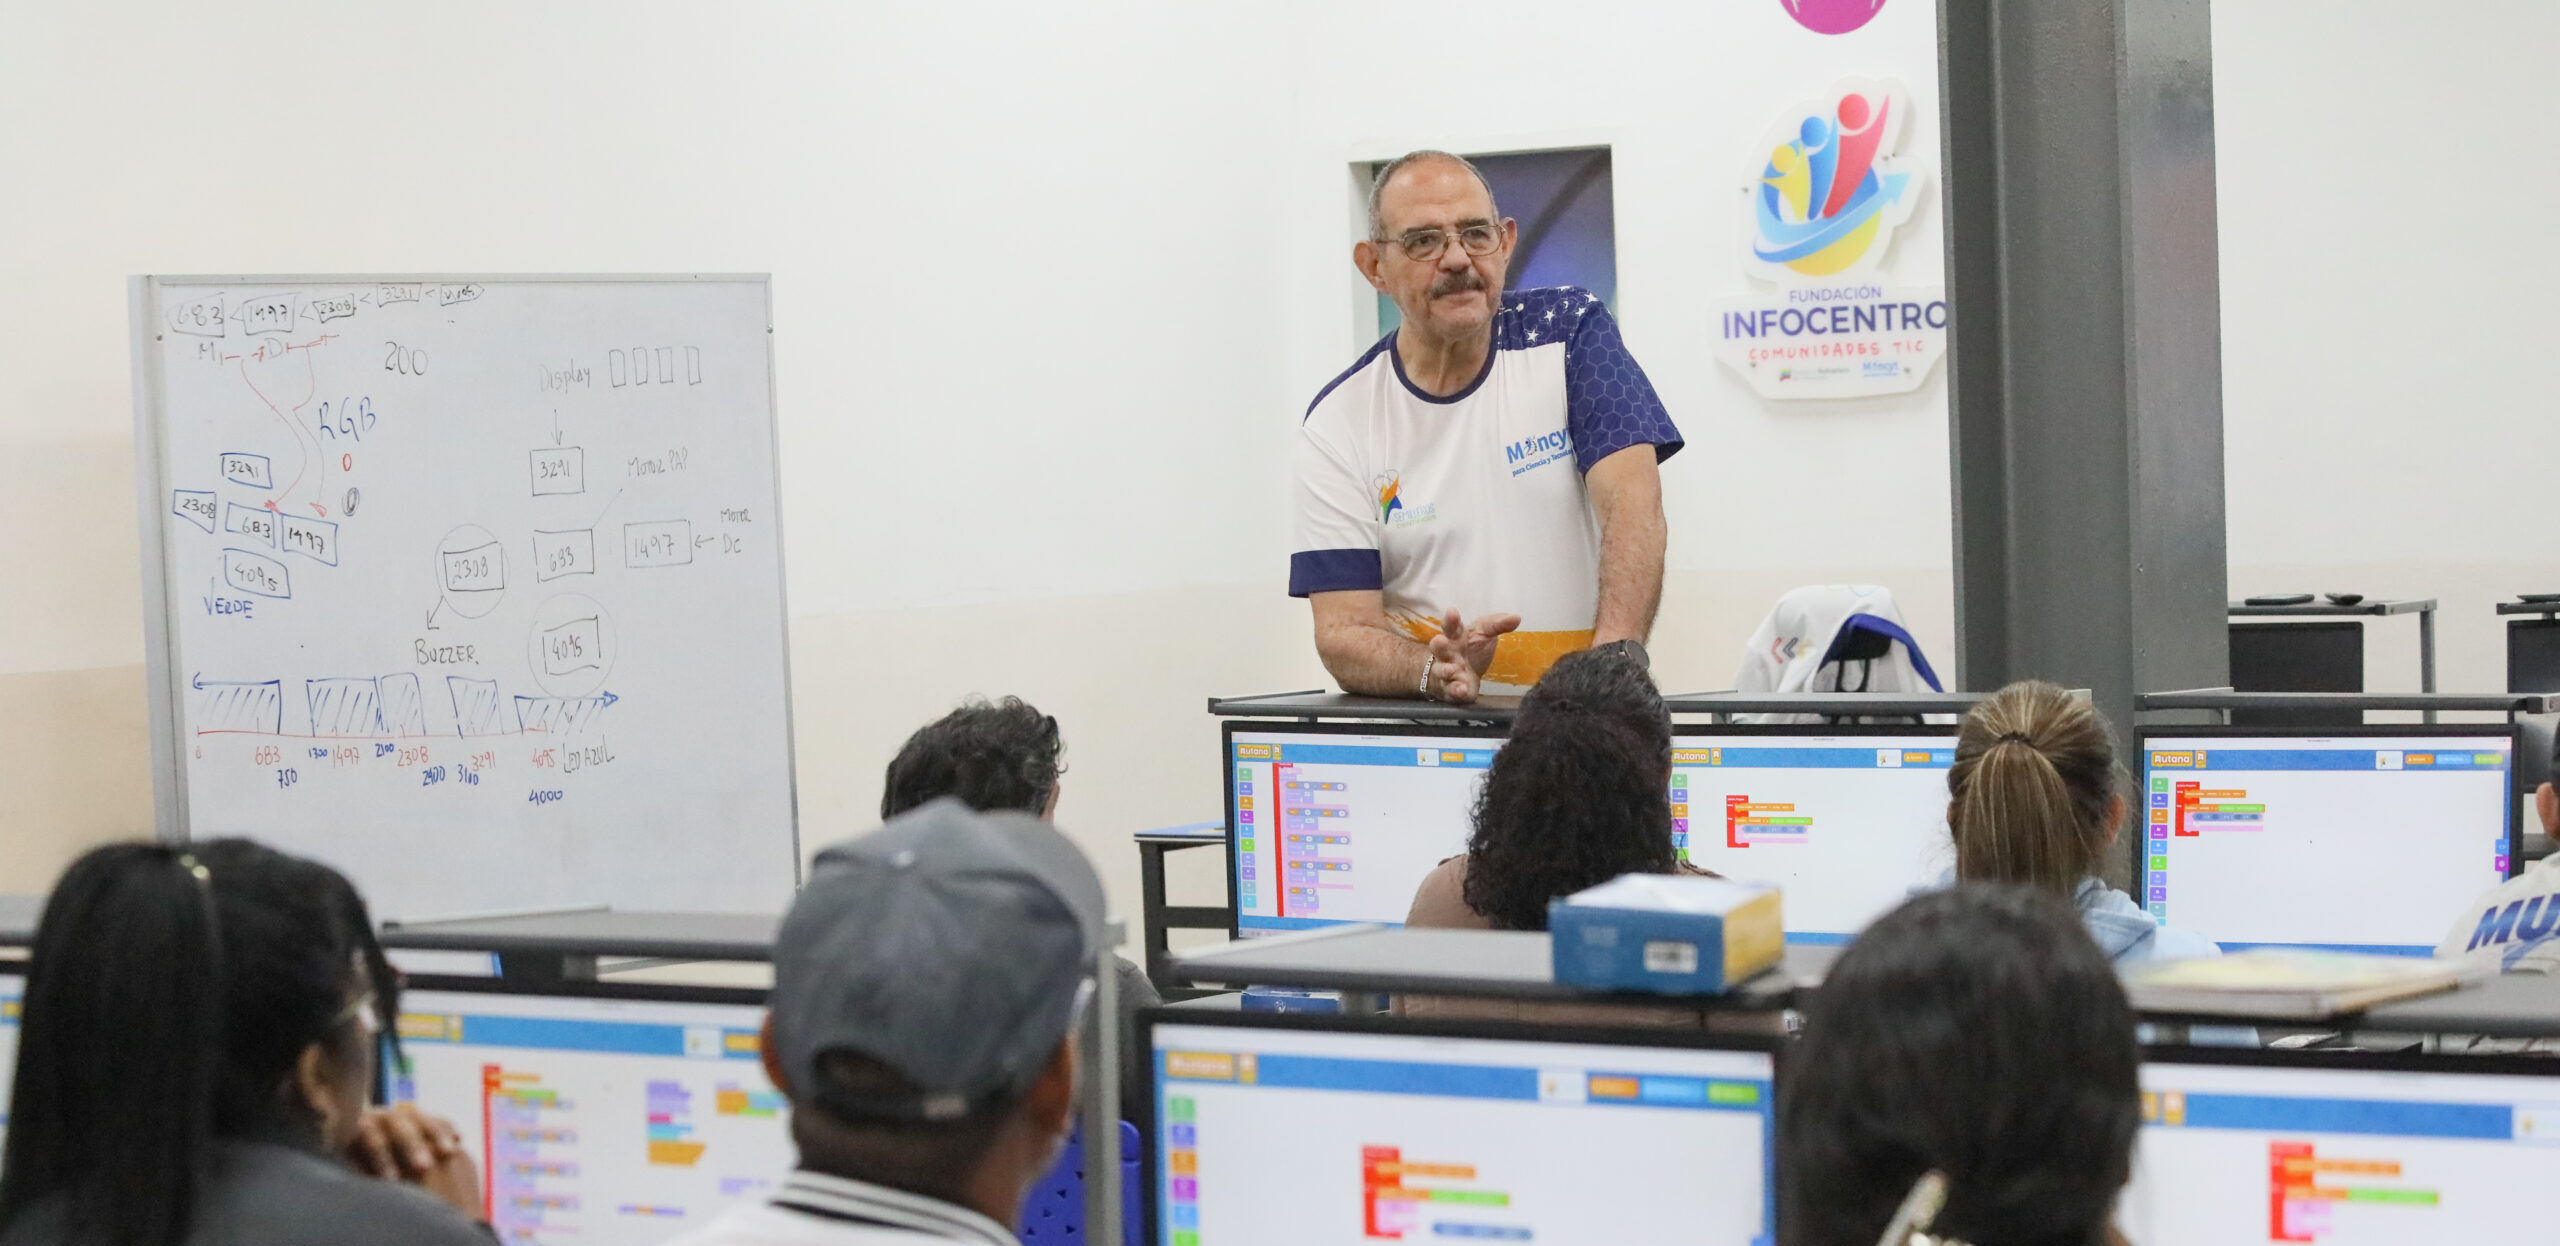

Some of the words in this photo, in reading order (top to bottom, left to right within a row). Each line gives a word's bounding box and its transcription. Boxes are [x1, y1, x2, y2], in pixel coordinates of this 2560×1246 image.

[1789, 282, 1882, 302] FUNDACIÓN
[1723, 301, 1947, 340] INFOCENTRO
[384, 341, 429, 376] 200
[1749, 341, 1881, 361] COMUNIDADES
[1892, 339, 1924, 354] TIC
[538, 358, 590, 396] Display
[319, 397, 376, 441] RGB
[539, 458, 571, 479] 3291
[182, 498, 216, 519] 2308
[242, 517, 271, 539] 683
[289, 527, 324, 554] 1497
[634, 533, 675, 558] 1497
[235, 562, 278, 591] 4095
[452, 556, 489, 584] 2308
[203, 576, 254, 619] VERDE
[255, 745, 281, 765] 683
[332, 743, 361, 768] 1497
[397, 746, 429, 767] 2308
[471, 751, 496, 771] 3291
[532, 749, 555, 768] 4095
[277, 768, 297, 789] 750
[528, 789, 563, 805] 4000
[2465, 893, 2560, 953] MU
